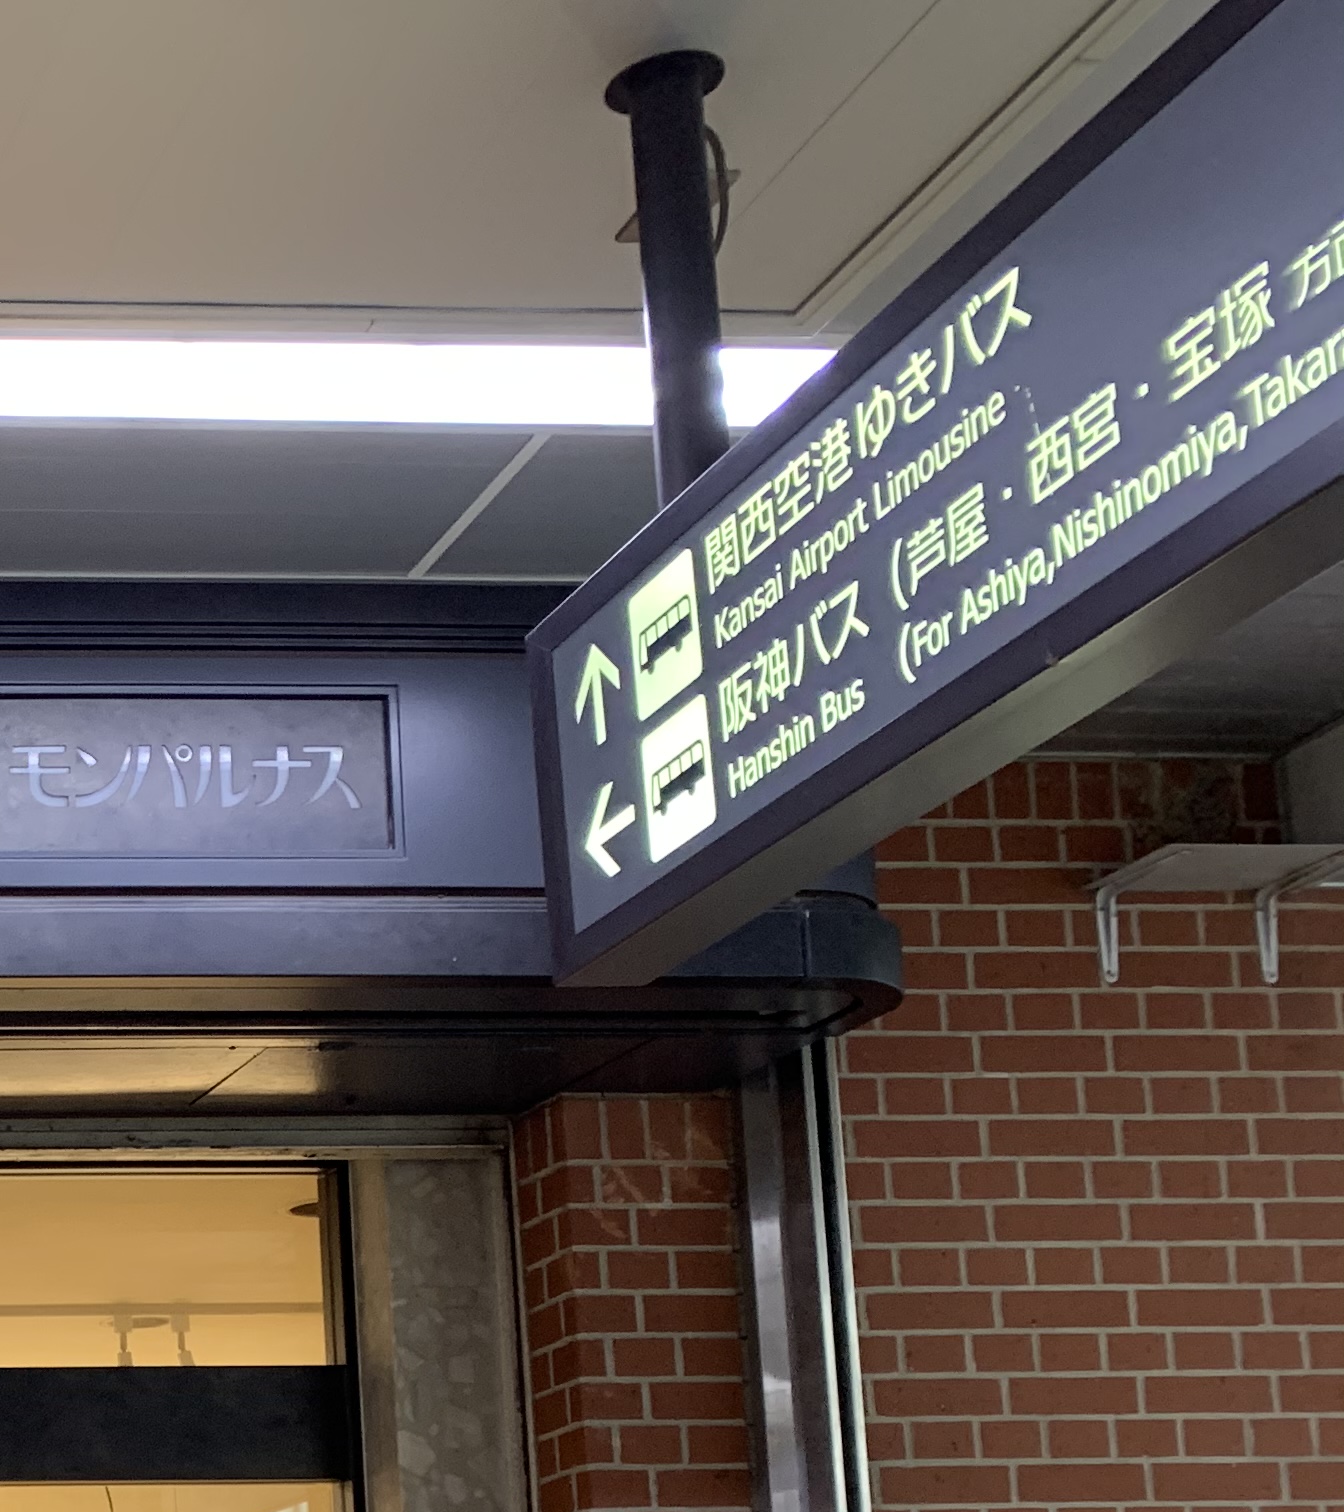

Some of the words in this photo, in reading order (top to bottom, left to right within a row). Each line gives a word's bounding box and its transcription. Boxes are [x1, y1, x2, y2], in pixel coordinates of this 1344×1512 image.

[702, 266, 1034, 596] 関西空港ゆきバス
[713, 578, 785, 651] Kansai
[789, 494, 870, 590] Airport
[873, 388, 1008, 516] Limousine
[717, 581, 870, 743] 阪神バス
[728, 712, 816, 800] Hanshin
[820, 677, 866, 737] Bus
[897, 612, 953, 684] (For
[9, 744, 362, 809] モンパルナス
